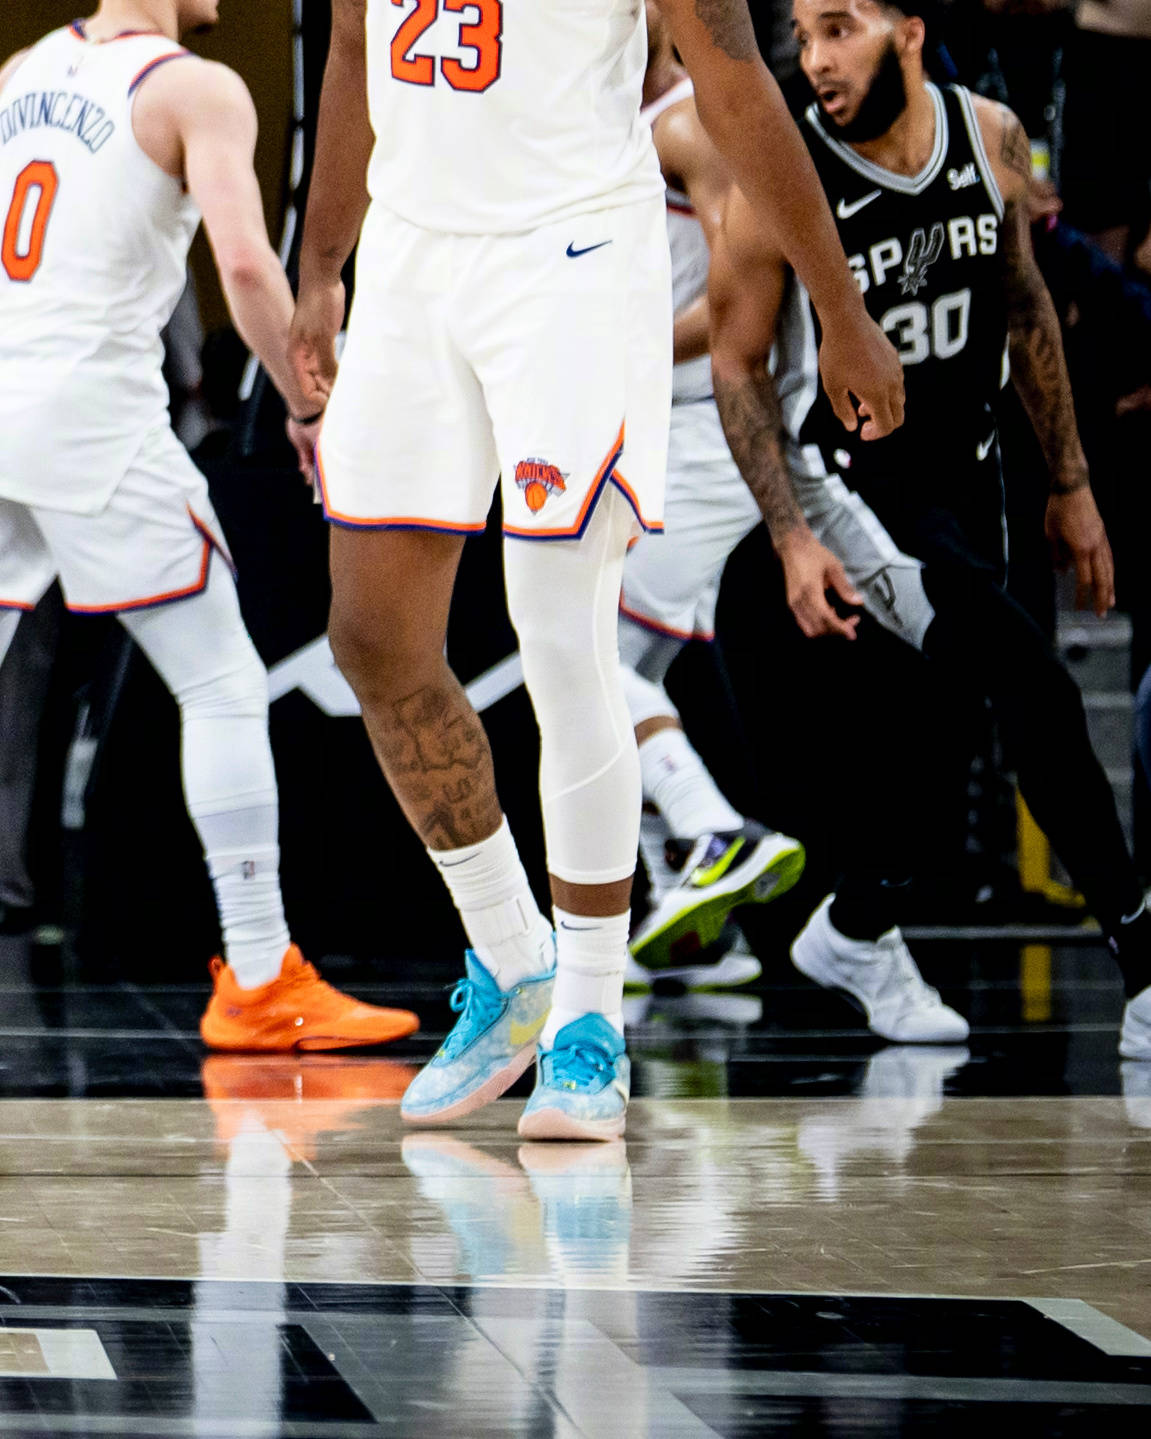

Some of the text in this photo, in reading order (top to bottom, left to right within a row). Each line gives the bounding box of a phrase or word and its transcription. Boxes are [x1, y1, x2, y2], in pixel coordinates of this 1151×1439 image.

[0, 90, 116, 155] DIVINCENZO
[1, 158, 60, 283] 0
[881, 287, 972, 366] 30
